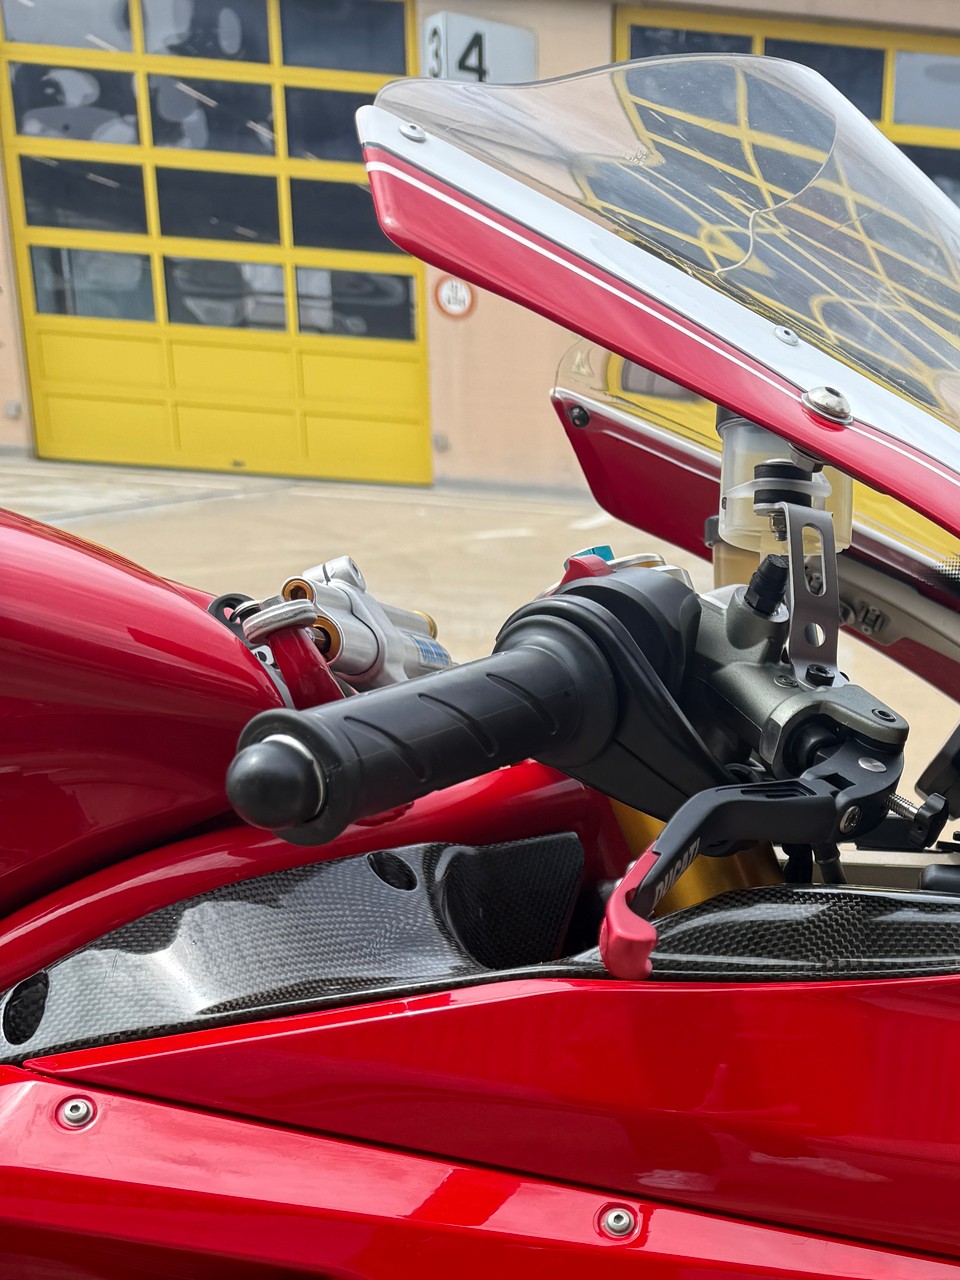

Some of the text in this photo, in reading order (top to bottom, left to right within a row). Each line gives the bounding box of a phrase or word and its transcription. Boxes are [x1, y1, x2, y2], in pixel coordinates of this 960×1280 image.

[428, 27, 442, 78] 3
[458, 31, 488, 82] 4
[652, 836, 700, 910] DUCATI
